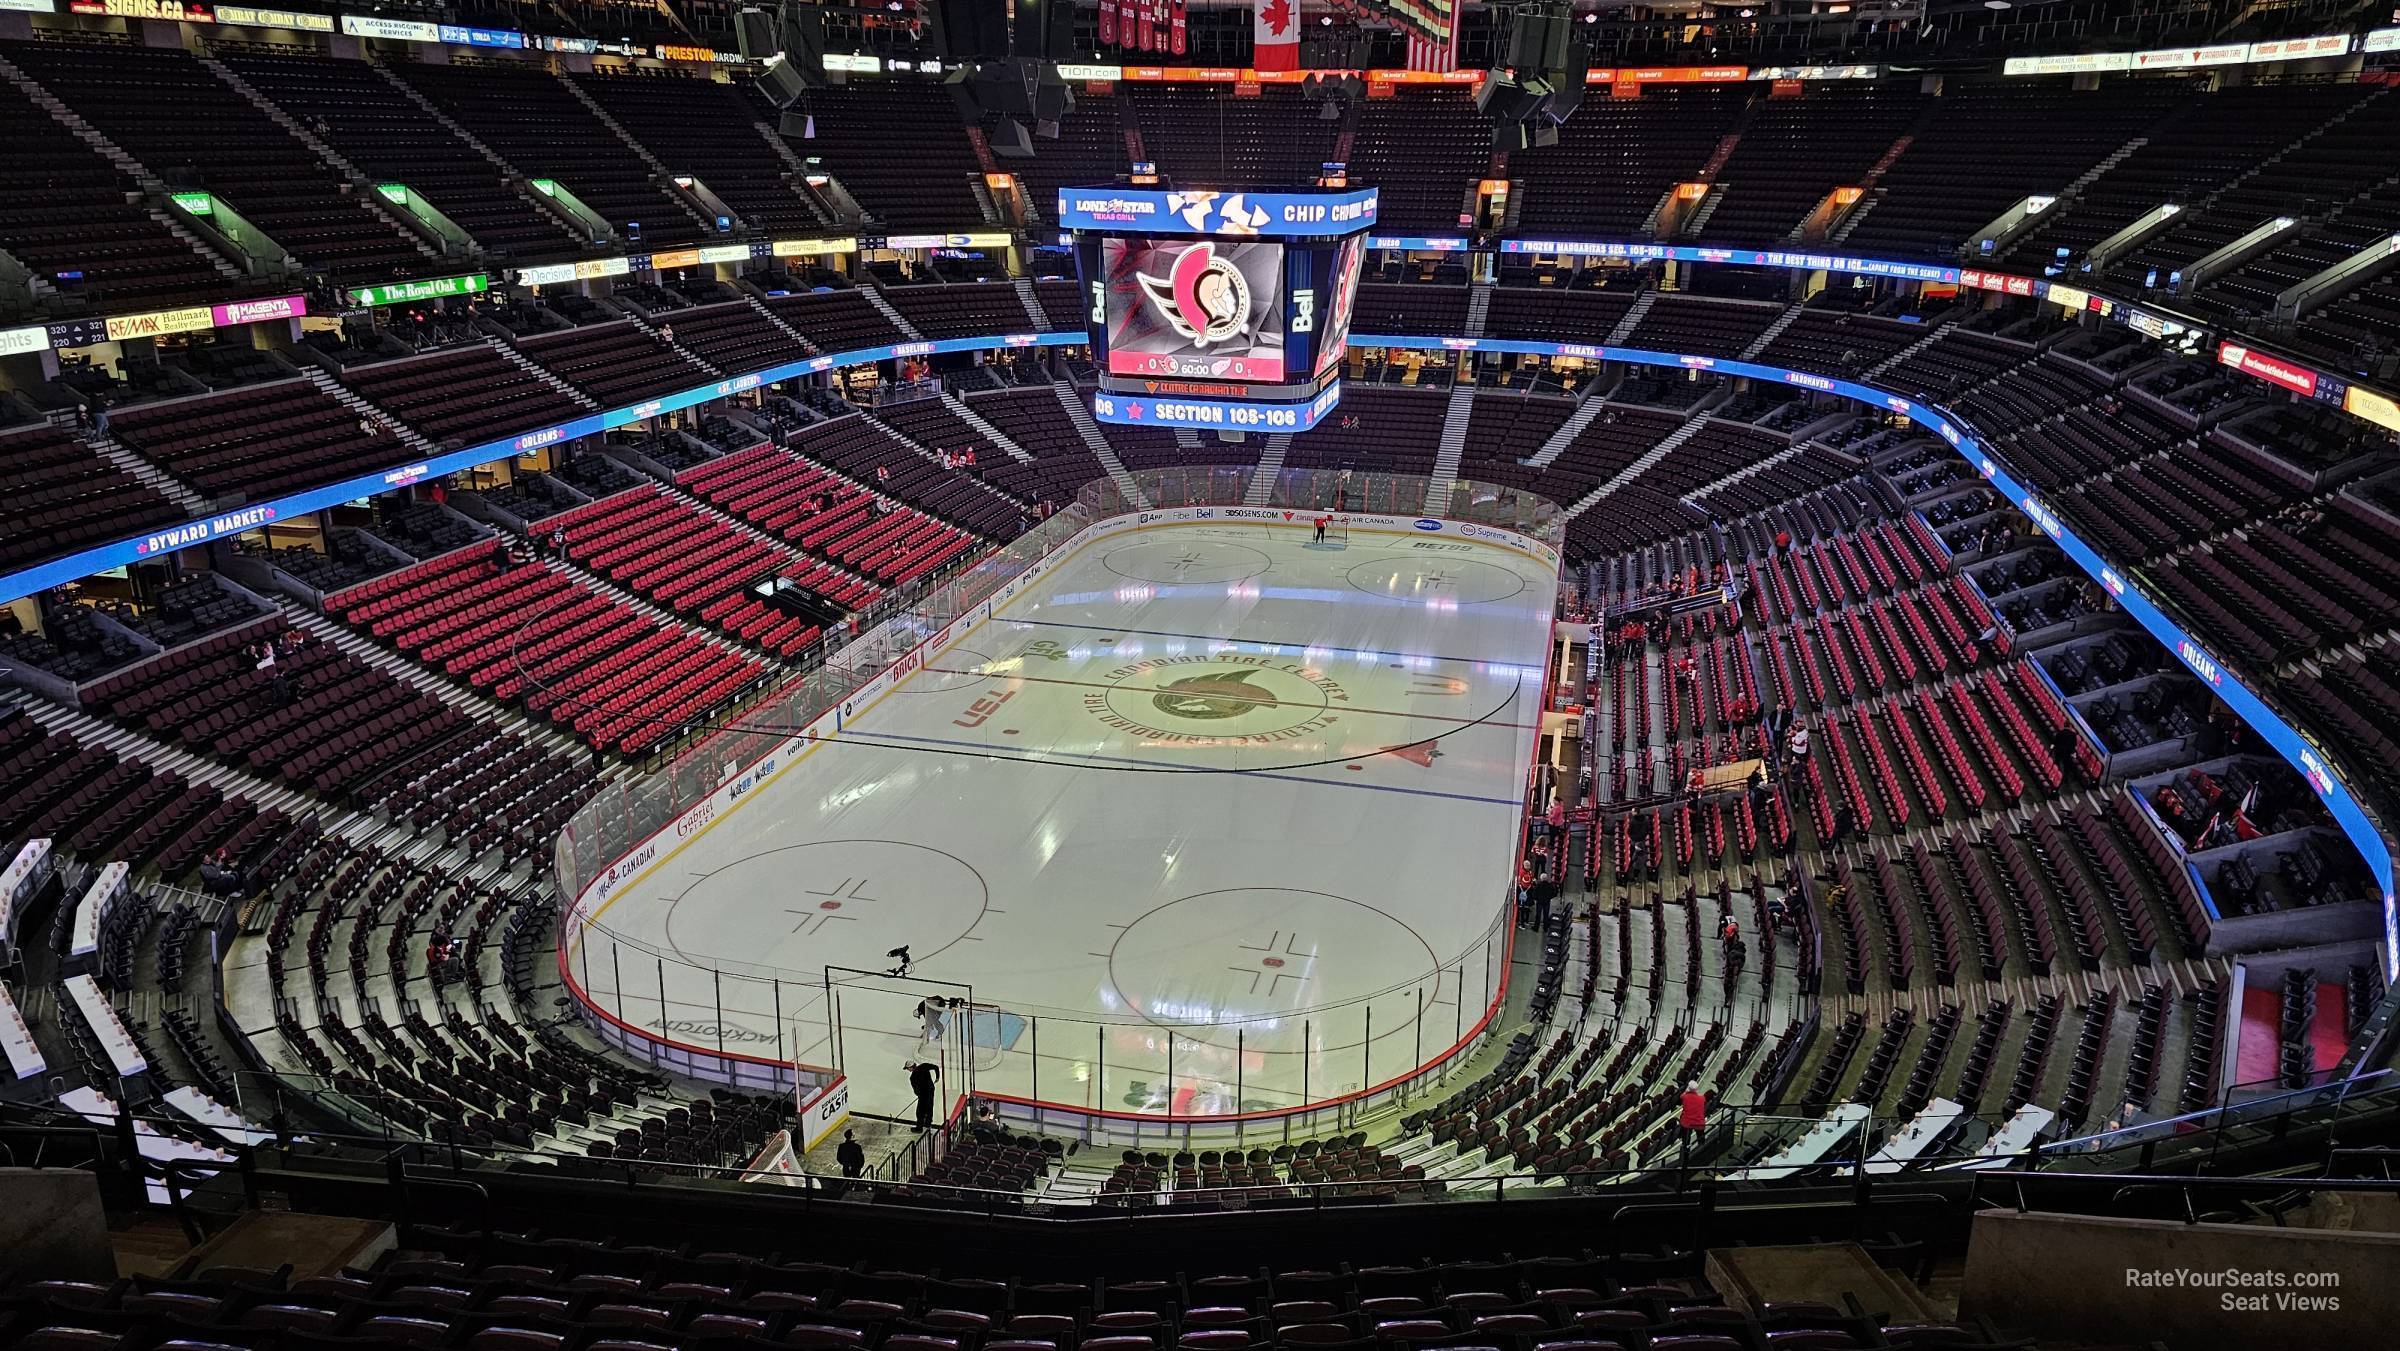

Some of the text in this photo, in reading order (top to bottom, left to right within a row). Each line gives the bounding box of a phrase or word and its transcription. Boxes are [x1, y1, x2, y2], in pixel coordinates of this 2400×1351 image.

[105, 0, 184, 19] SIGNS.CA
[379, 29, 413, 37] SERVICES
[666, 46, 714, 62] PRESTON
[1076, 200, 1155, 214] LONE STAR
[1284, 205, 1326, 222] CHIP
[1092, 213, 1115, 221] TEXAS
[1523, 242, 1554, 251] FROZEN
[1556, 243, 1606, 253] MARGARITAS
[1768, 254, 1784, 264] THE
[1785, 256, 1805, 266] BEST
[1807, 257, 1831, 268] THING
[1908, 267, 1918, 276] THE
[531, 265, 572, 283] Decisive
[383, 279, 456, 300] The Royal Oak
[240, 300, 291, 316] MAGENTA
[1093, 281, 1104, 324] Bell
[1292, 289, 1314, 333] Bell
[51, 321, 103, 334] 320 321
[109, 309, 209, 338] RE/MAX Hallmark
[165, 319, 211, 331] Realty Group
[53, 334, 105, 347] 220 221
[1565, 346, 1596, 356] KANATA
[1149, 359, 1244, 375] 0 60:00 0
[1160, 383, 1248, 396] CENTRE CANADIAN TIRE
[1156, 404, 1297, 427] SECTION 105-106
[522, 430, 558, 449] ORLEANS
[1172, 508, 1214, 521] Fibe Bell
[1225, 509, 1278, 519] 5050SENS.COM
[149, 508, 266, 552] BYWARD MARKET
[230, 533, 241, 542] 115
[1478, 528, 1507, 541] Supreme
[893, 653, 918, 683] BRICK
[2183, 643, 2216, 682] ORLEANS
[1104, 655, 1344, 694] CANADIAN TIRE CENTRE
[677, 798, 714, 839] Gabriel
[689, 812, 715, 834] PIZZA
[622, 845, 656, 878] CANADIAN
[646, 1018, 785, 1045] JACKPOTCITY
